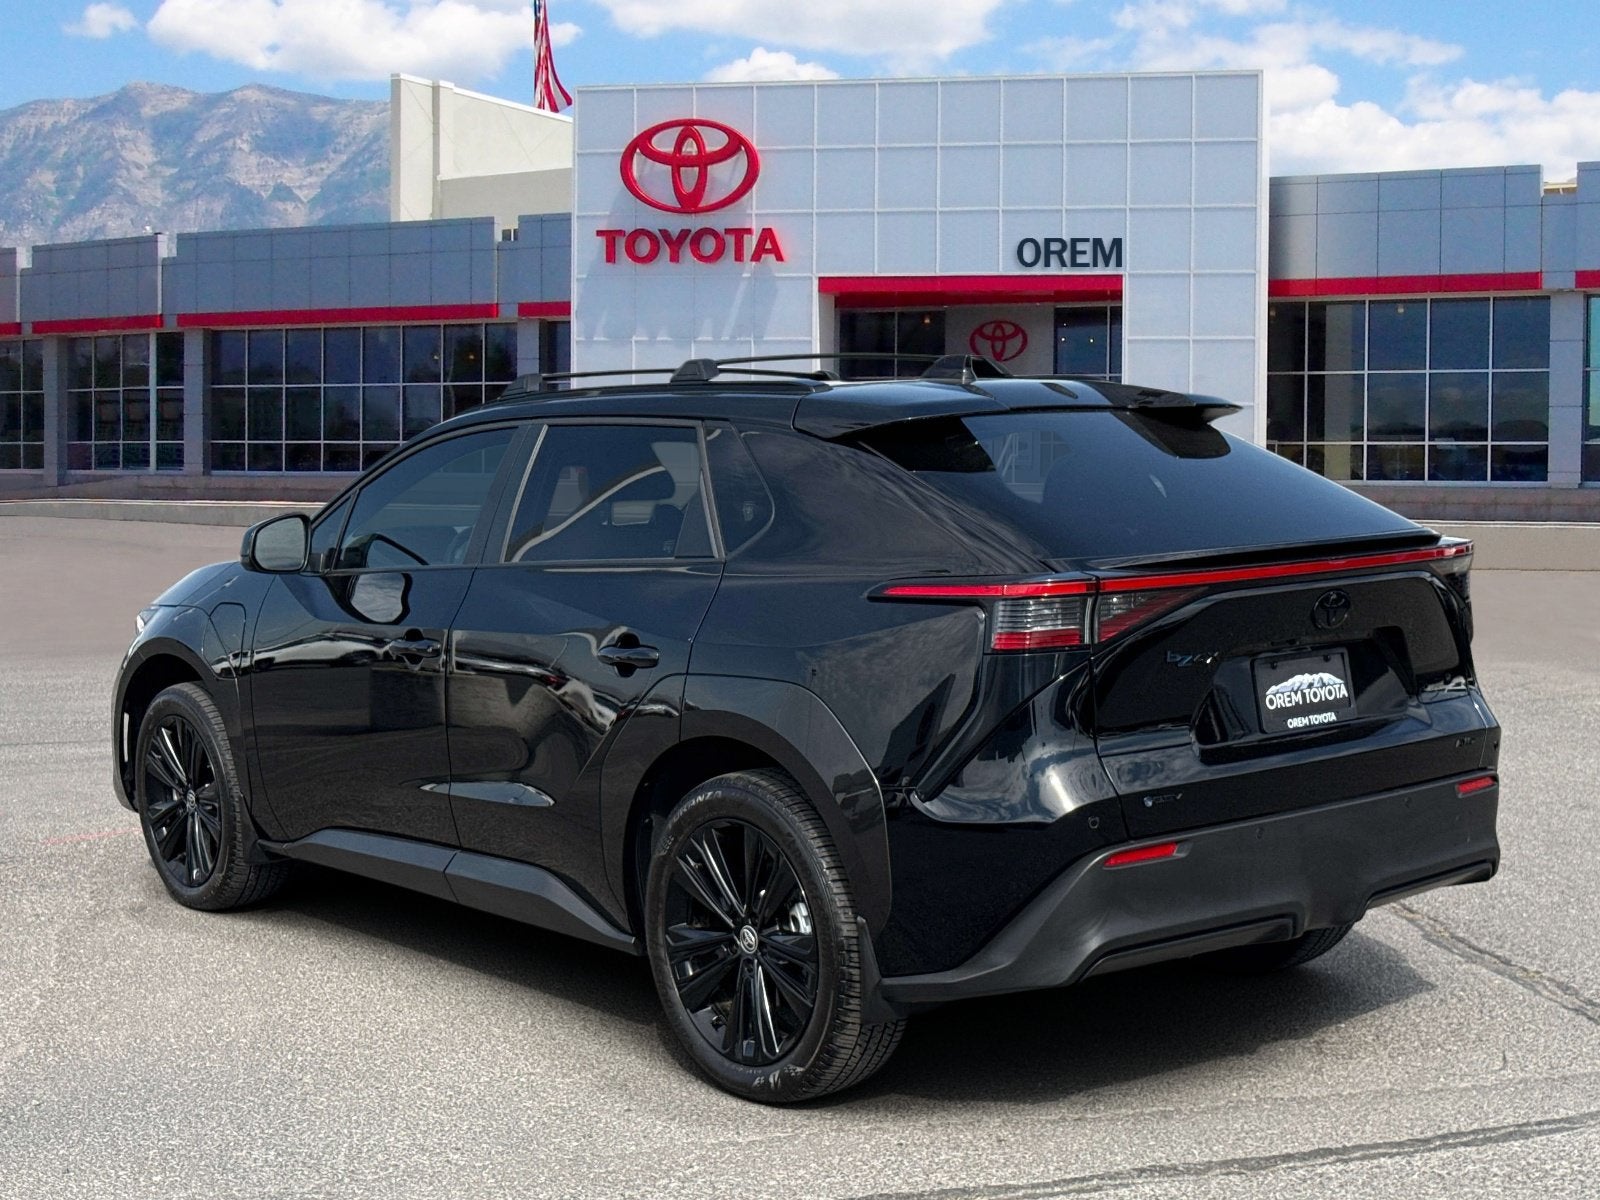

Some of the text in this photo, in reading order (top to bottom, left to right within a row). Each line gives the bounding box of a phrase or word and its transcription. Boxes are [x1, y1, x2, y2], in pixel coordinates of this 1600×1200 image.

[596, 227, 784, 264] TOYOTA
[1016, 237, 1123, 268] OREM
[1265, 684, 1348, 710] OREM TOYOTA
[1287, 712, 1336, 728] OREM TOYOTA
